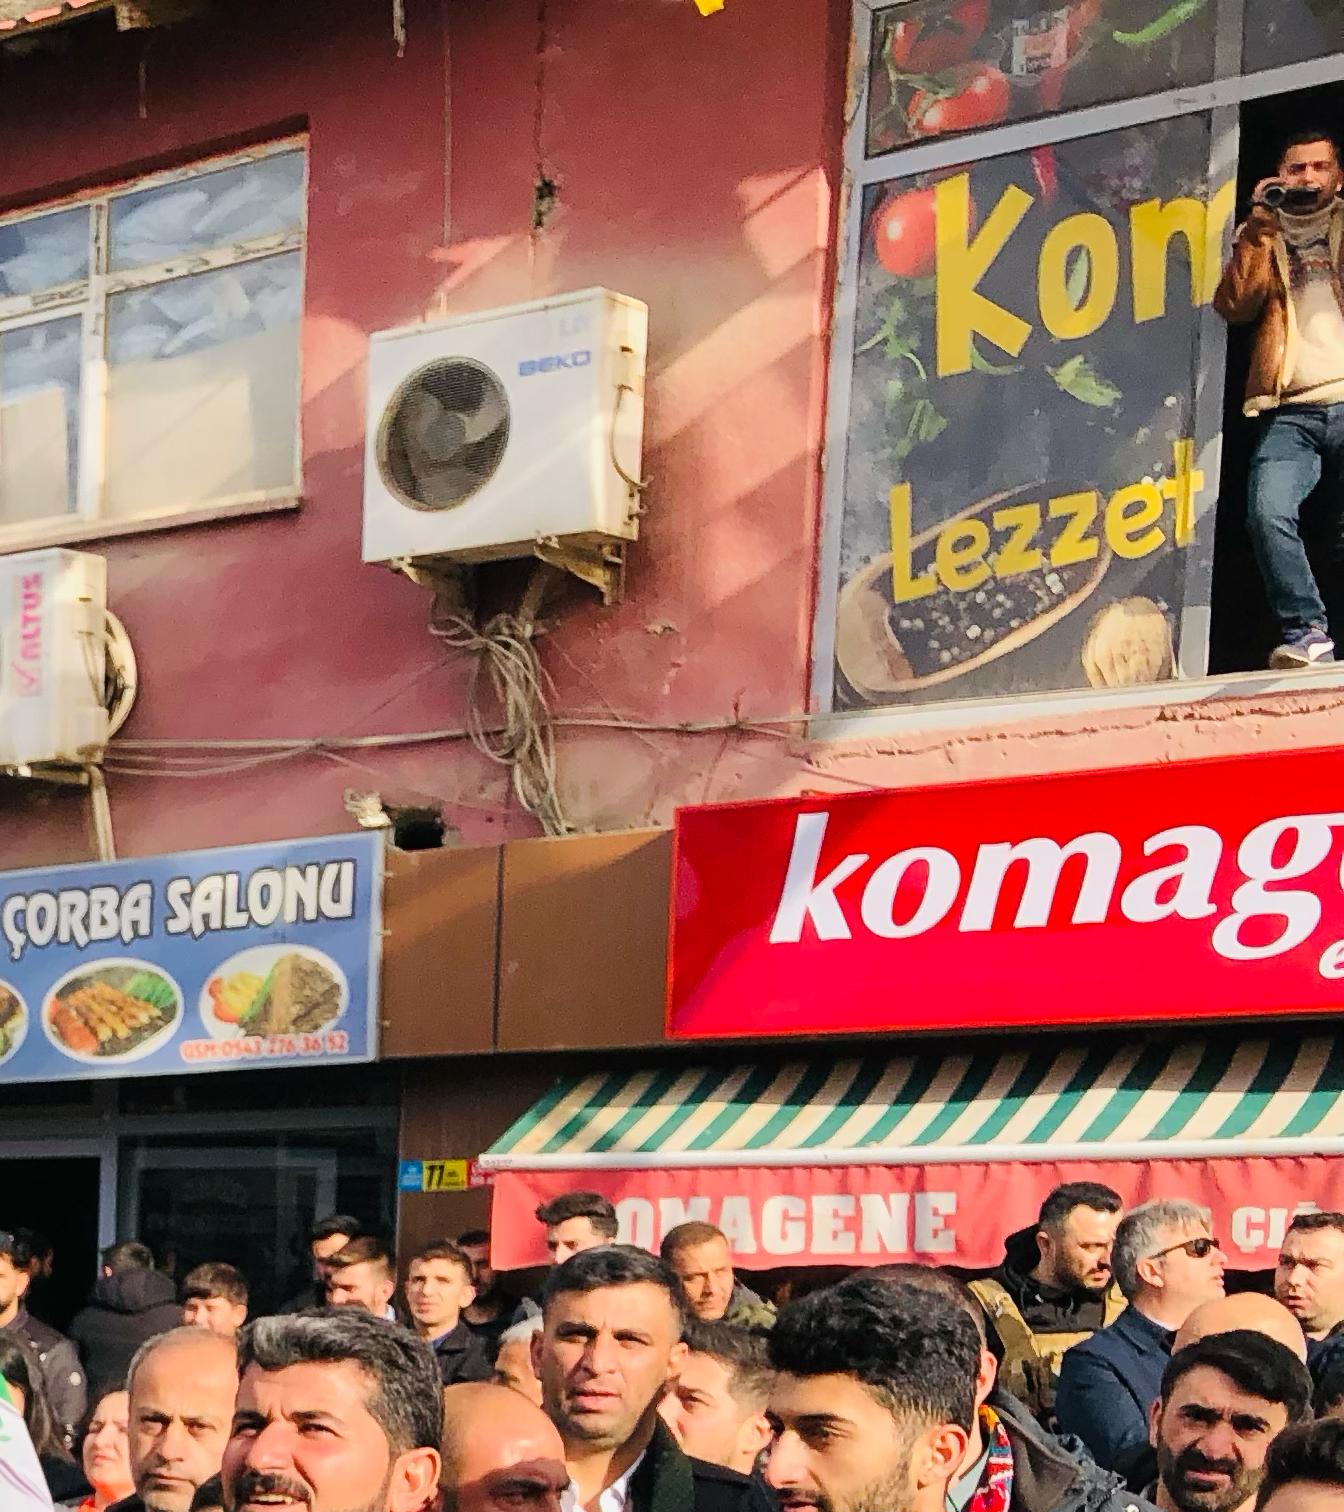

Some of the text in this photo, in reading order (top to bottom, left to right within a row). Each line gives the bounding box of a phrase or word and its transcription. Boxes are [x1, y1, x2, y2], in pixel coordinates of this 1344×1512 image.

[517, 350, 591, 377] BEKO
[890, 437, 1205, 604] Lezzet
[3, 882, 153, 962] ÇORBA
[165, 859, 357, 942] SALONU
[769, 811, 1344, 961] komag
[615, 1191, 958, 1255] OMAGENE
